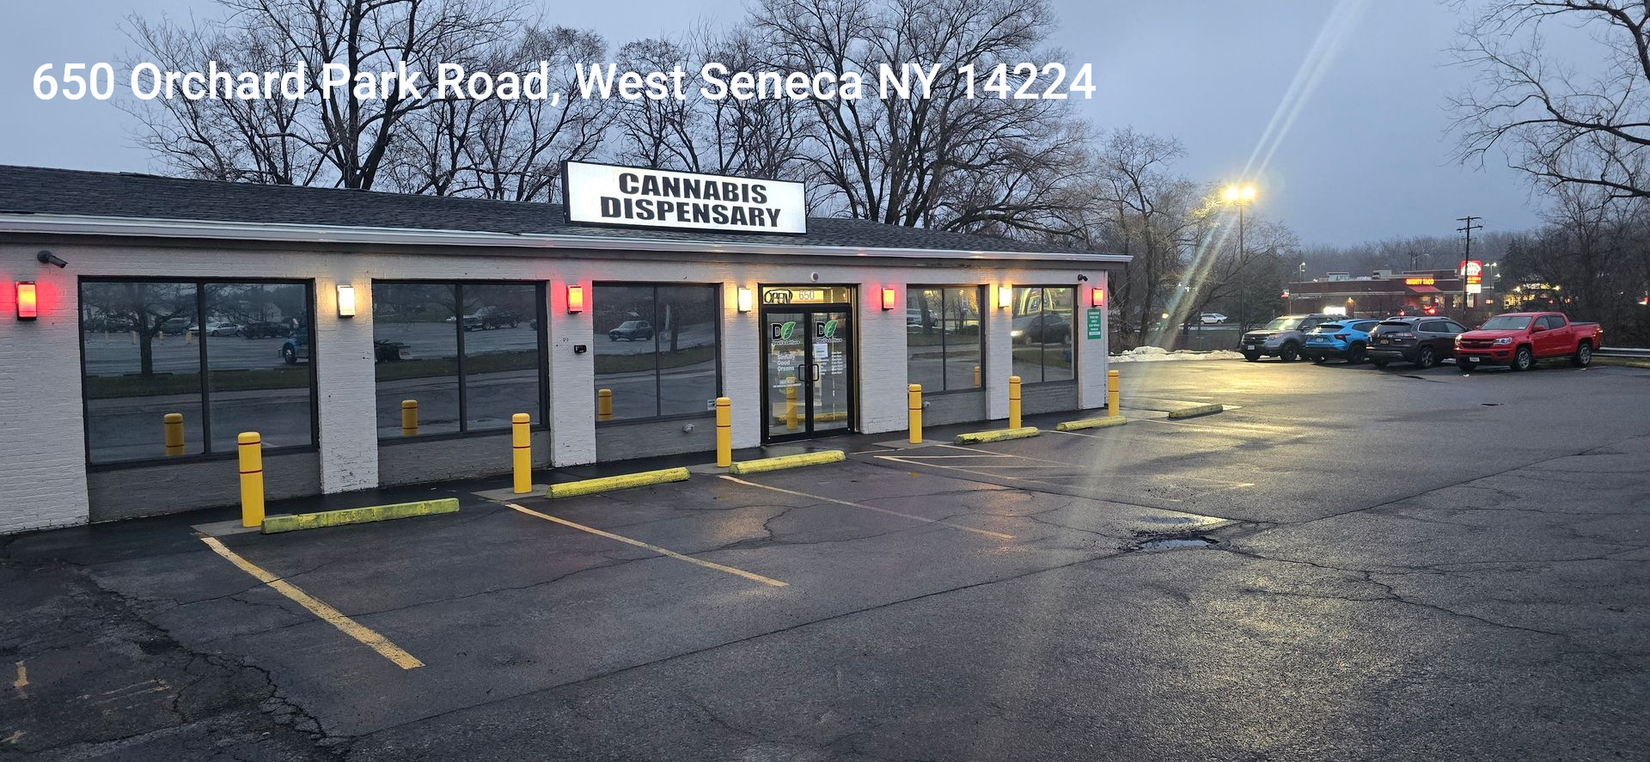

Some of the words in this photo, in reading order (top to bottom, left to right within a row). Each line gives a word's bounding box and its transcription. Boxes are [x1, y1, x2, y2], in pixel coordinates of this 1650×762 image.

[618, 172, 768, 204] CANNABIS
[600, 196, 781, 227] DISPENSARY
[764, 289, 792, 304] OPEN
[798, 289, 815, 300] 650
